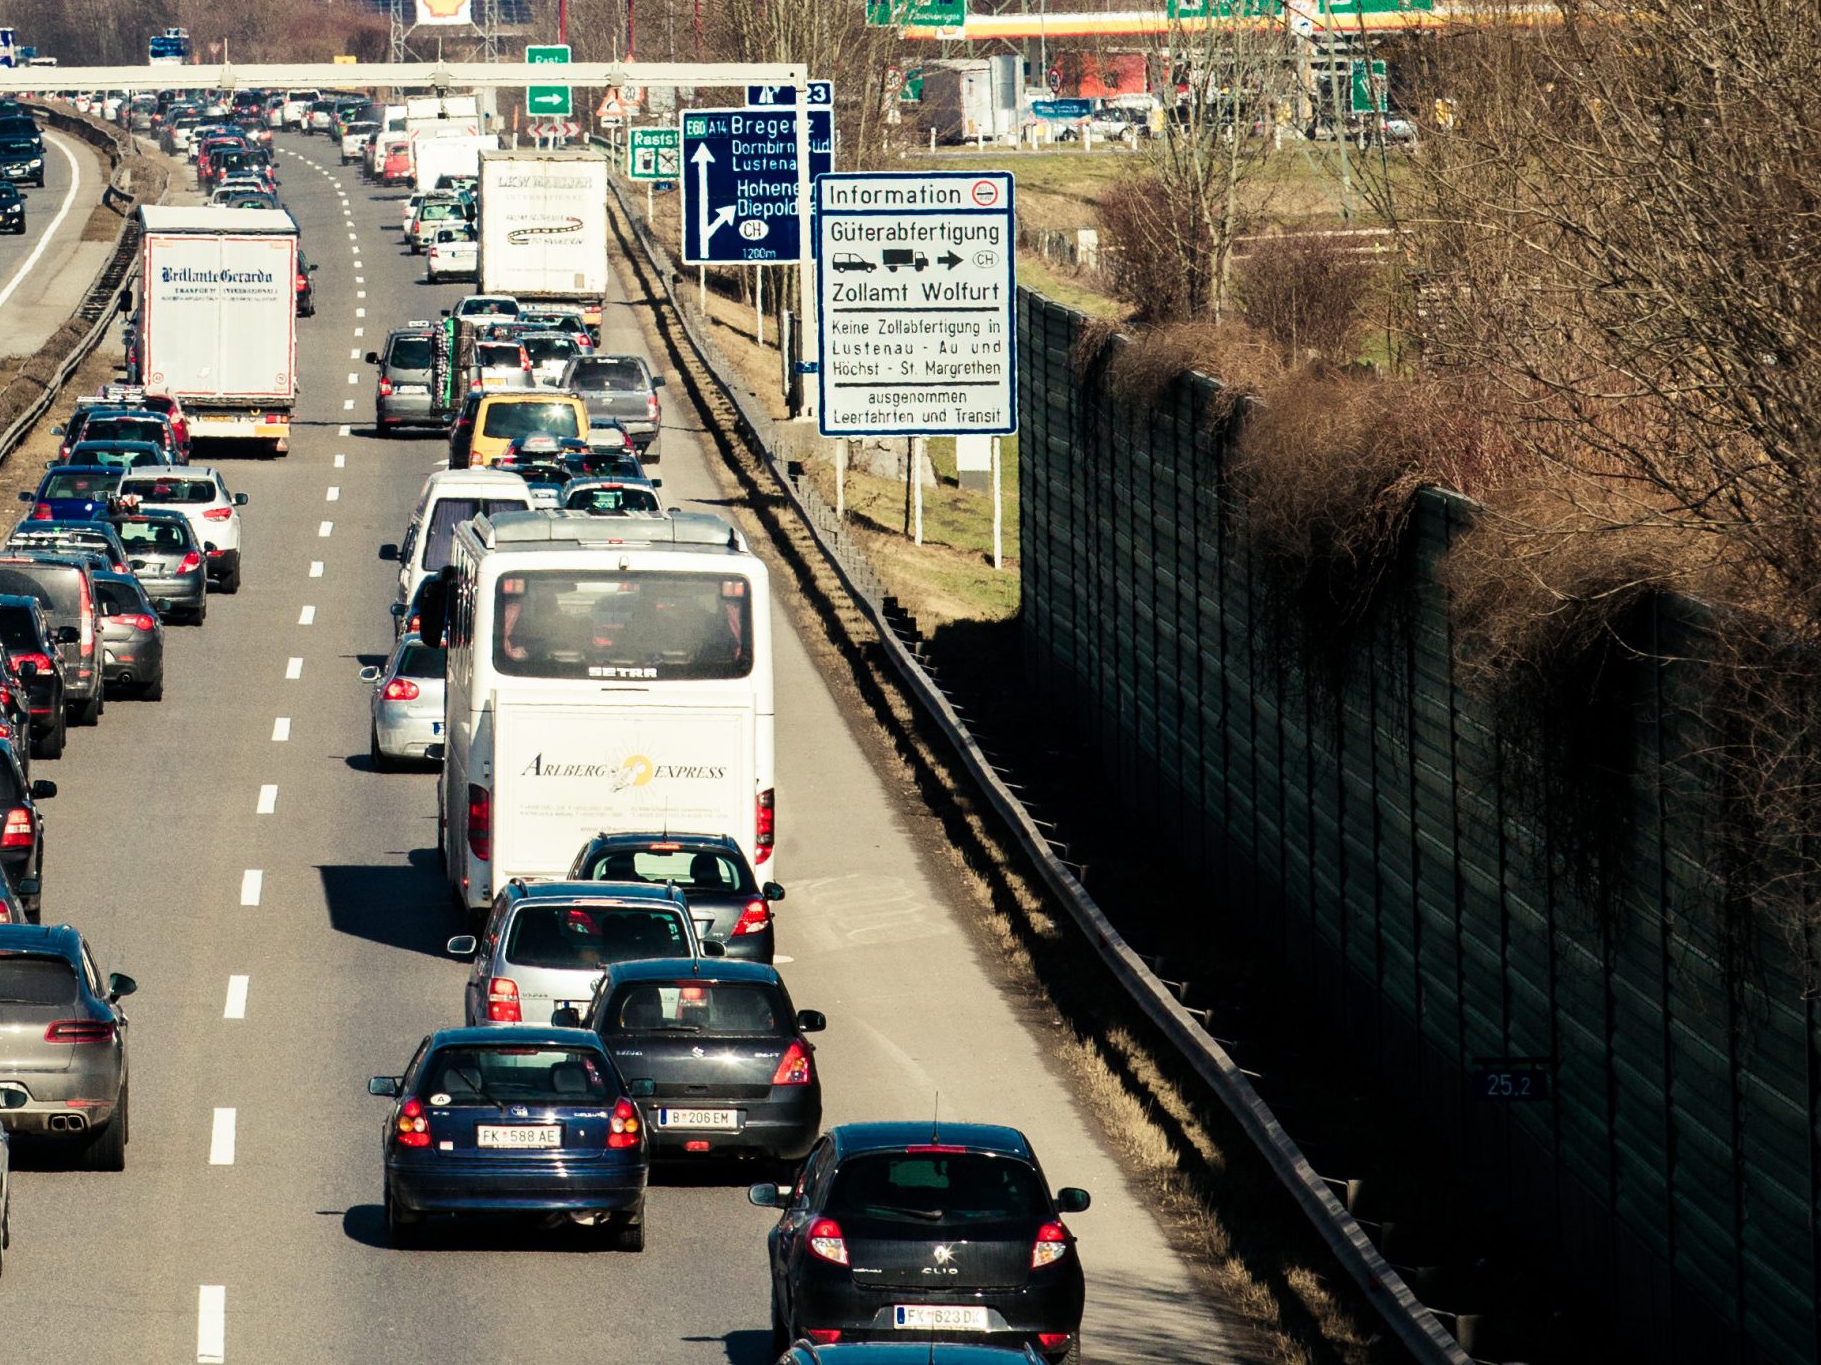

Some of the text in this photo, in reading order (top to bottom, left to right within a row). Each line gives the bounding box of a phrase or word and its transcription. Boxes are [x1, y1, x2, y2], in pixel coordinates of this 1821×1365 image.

[686, 120, 728, 135] E60 A14
[732, 139, 795, 155] Dornbirn
[732, 156, 797, 172] Lustena
[830, 184, 961, 204] Information
[744, 222, 761, 237] CH
[831, 221, 1000, 245] Güterabfertigung
[742, 248, 777, 259] 1200m
[976, 254, 994, 266] CH
[220, 268, 273, 283] Gerardo
[833, 282, 1000, 302] Zollamt Wolfurt
[832, 318, 1001, 337] Keine Zollabfertigung in
[832, 341, 914, 355] Lustenau
[939, 340, 958, 355] Au
[972, 340, 1001, 354] und
[833, 360, 879, 376] Höchst
[925, 359, 1001, 378] Margrethen
[868, 391, 967, 408] ausgenommen
[834, 407, 1001, 424] Leerfahrten und Transit
[589, 666, 658, 678] SETRA
[521, 752, 728, 779] ARLBERG EXPRESS
[689, 1112, 711, 1124] 206
[713, 1112, 729, 1124] EM
[483, 1130, 555, 1143] FK 588 AE
[920, 1267, 959, 1275] CLIO
[934, 1310, 961, 1323] 623
